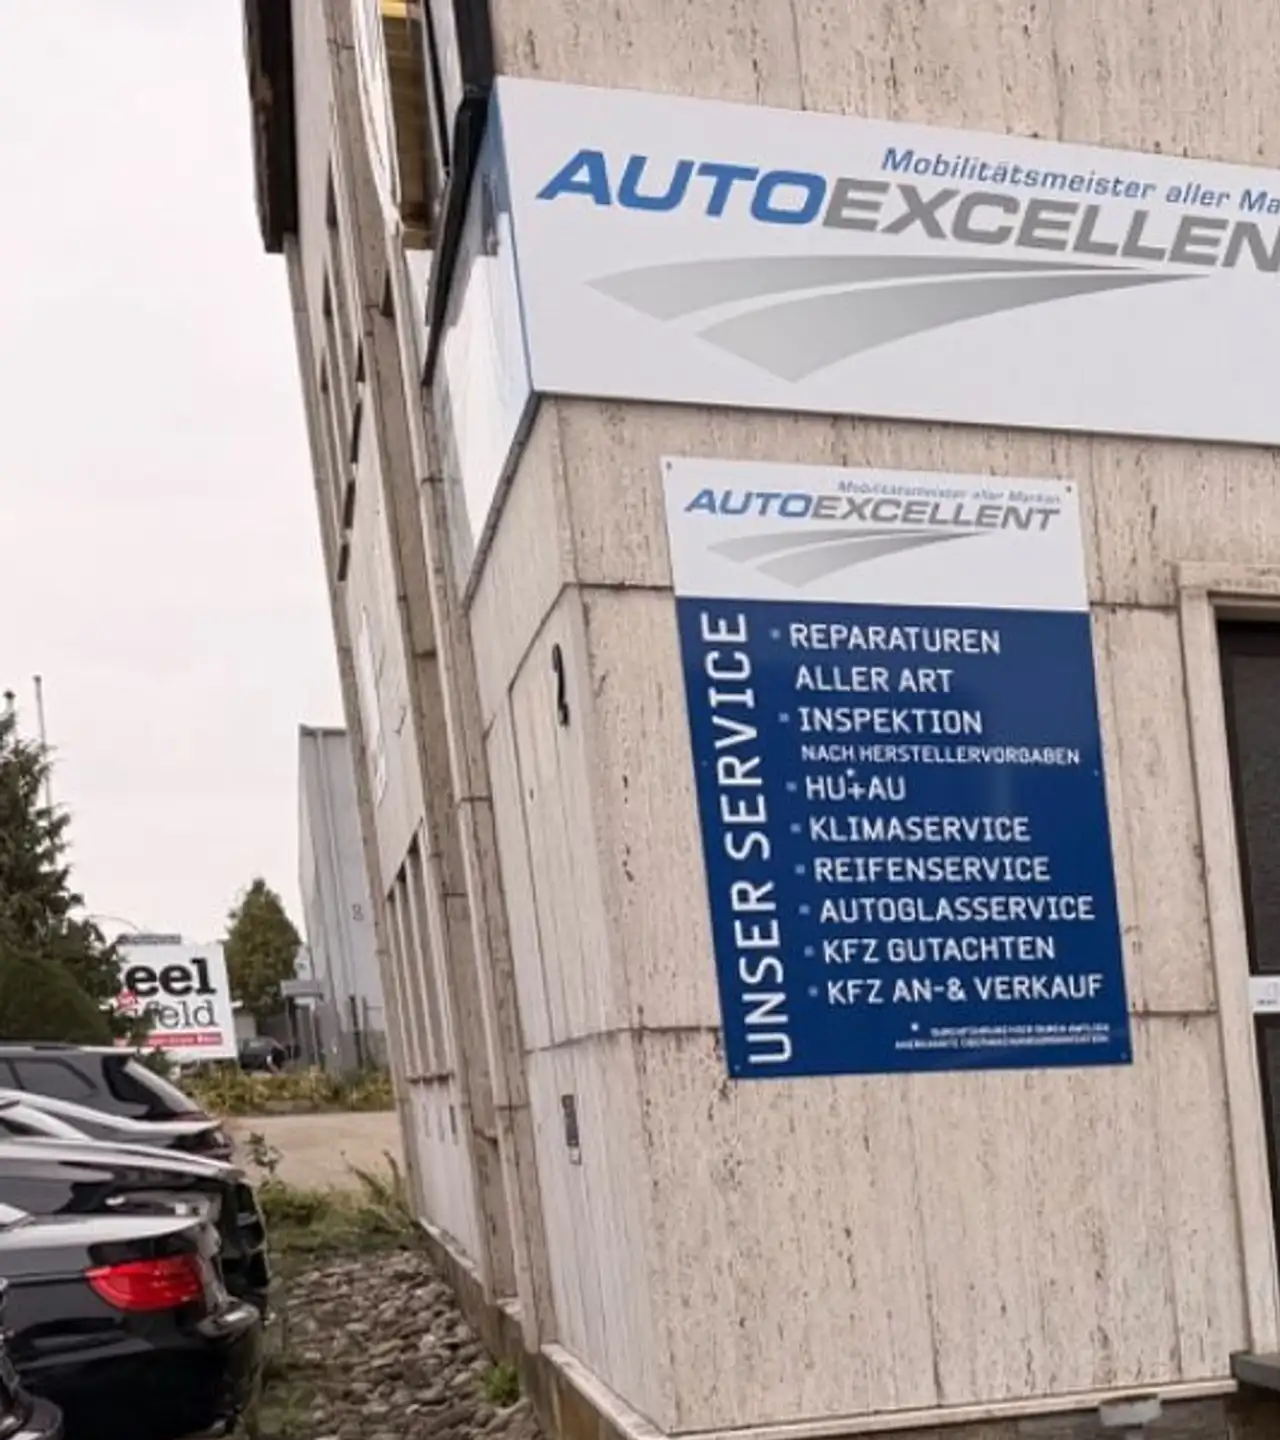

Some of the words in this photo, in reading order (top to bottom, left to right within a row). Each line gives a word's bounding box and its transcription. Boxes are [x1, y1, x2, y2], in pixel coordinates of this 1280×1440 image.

[880, 146, 1156, 200] Mobilitätsmeister
[1165, 181, 1231, 209] aller
[684, 488, 1062, 532] AUTOEXCELLENT
[789, 623, 1000, 655] REPARATUREN
[795, 666, 889, 692] ALLER
[898, 669, 954, 693] ART
[798, 707, 983, 735] INSPEKTION
[700, 612, 771, 862] SERVICE
[801, 744, 853, 762] NACH
[859, 745, 1080, 765] HERSTELLERVORGABEN
[810, 816, 1031, 843] KLIMASERVICE
[814, 857, 1051, 882] REIFENSERVICE
[819, 896, 1096, 923] AUTOGLASSERVICE
[822, 938, 879, 964] KFZ
[887, 936, 1055, 963] GUTACHTEN
[730, 880, 793, 1064] UNSER
[827, 979, 884, 1005] KFZ
[975, 973, 1104, 1001] VERKAUF
